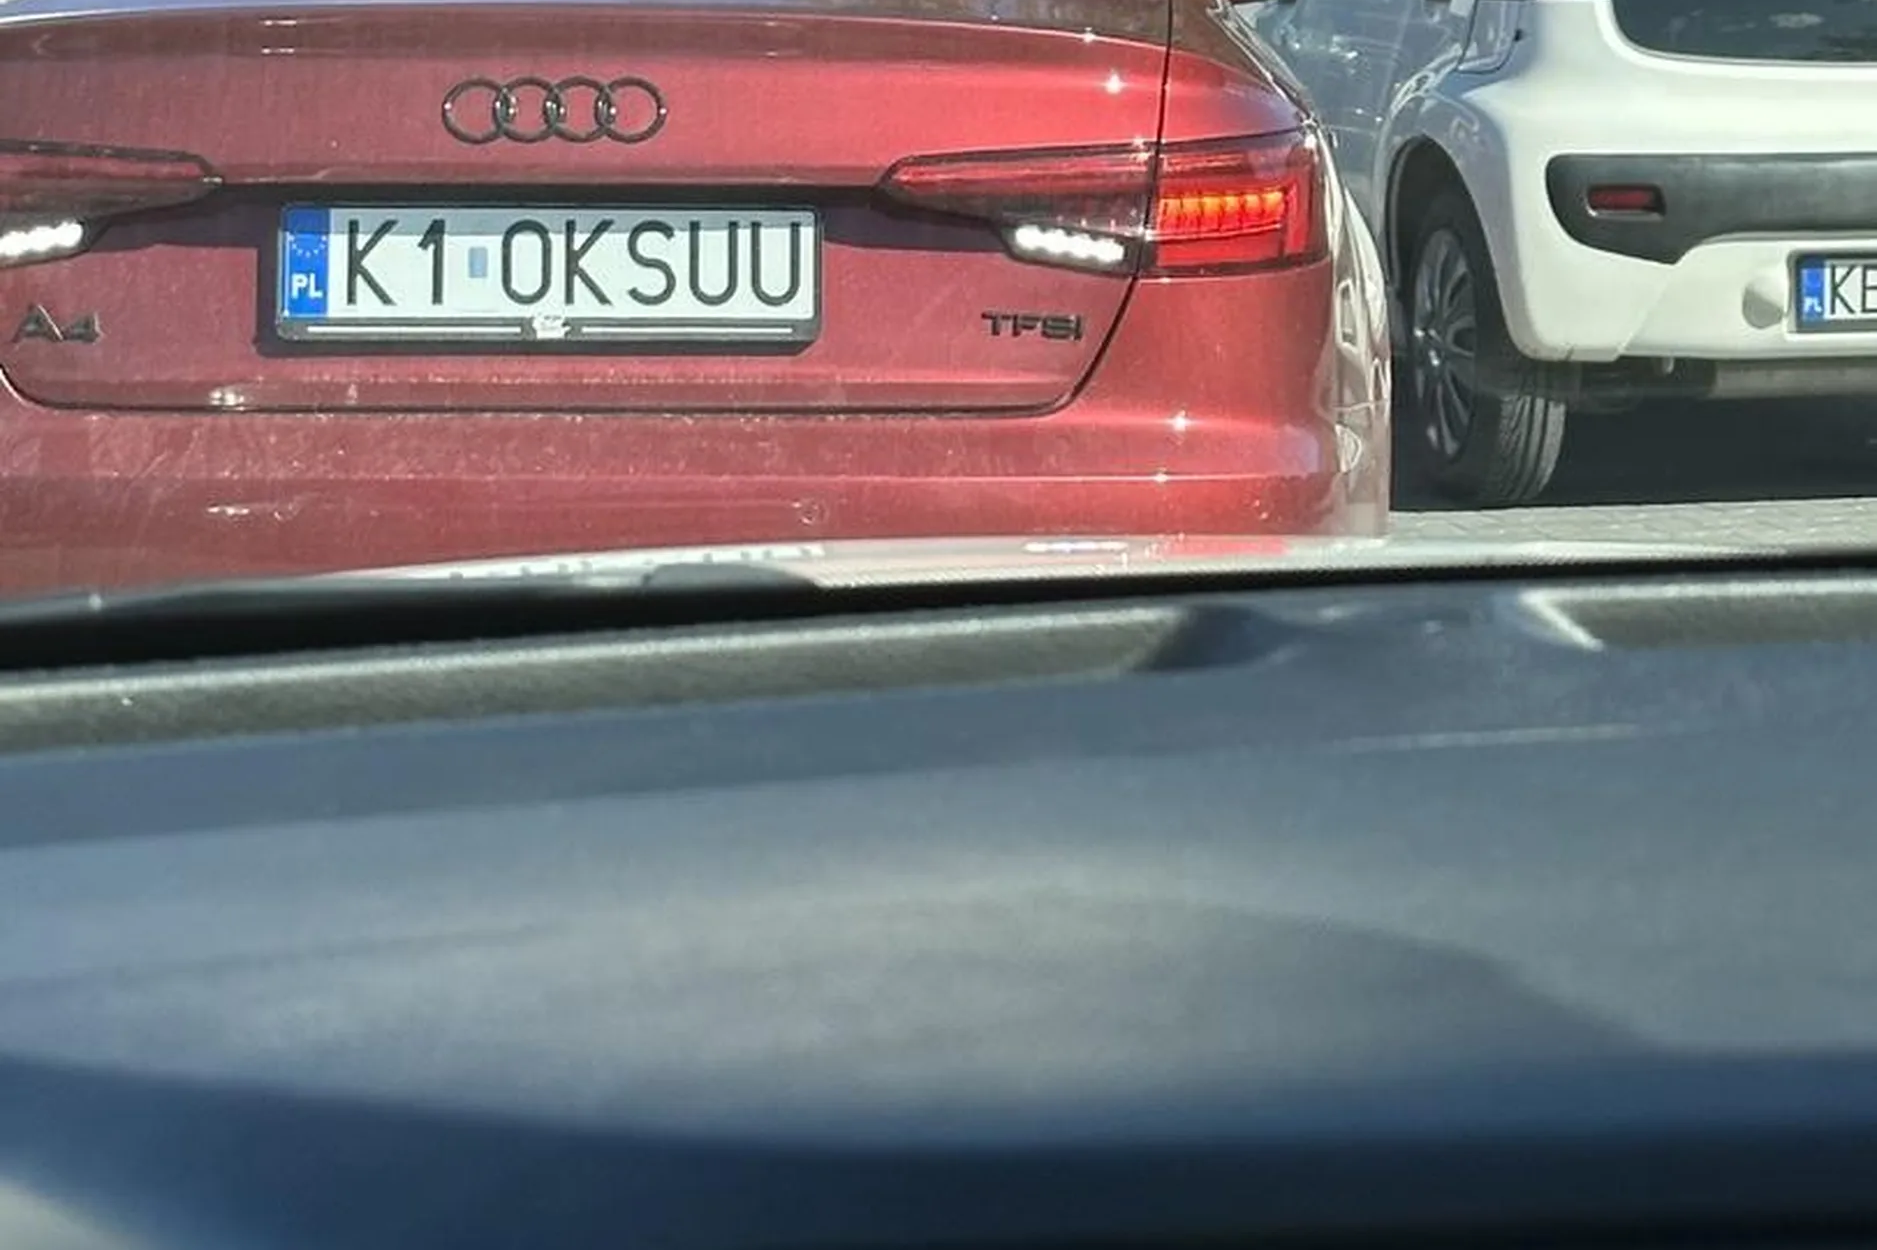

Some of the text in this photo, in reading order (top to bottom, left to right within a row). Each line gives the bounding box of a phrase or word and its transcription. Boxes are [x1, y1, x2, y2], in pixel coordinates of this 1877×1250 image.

[346, 218, 443, 306] K1
[291, 273, 323, 299] PL
[11, 303, 102, 344] A4
